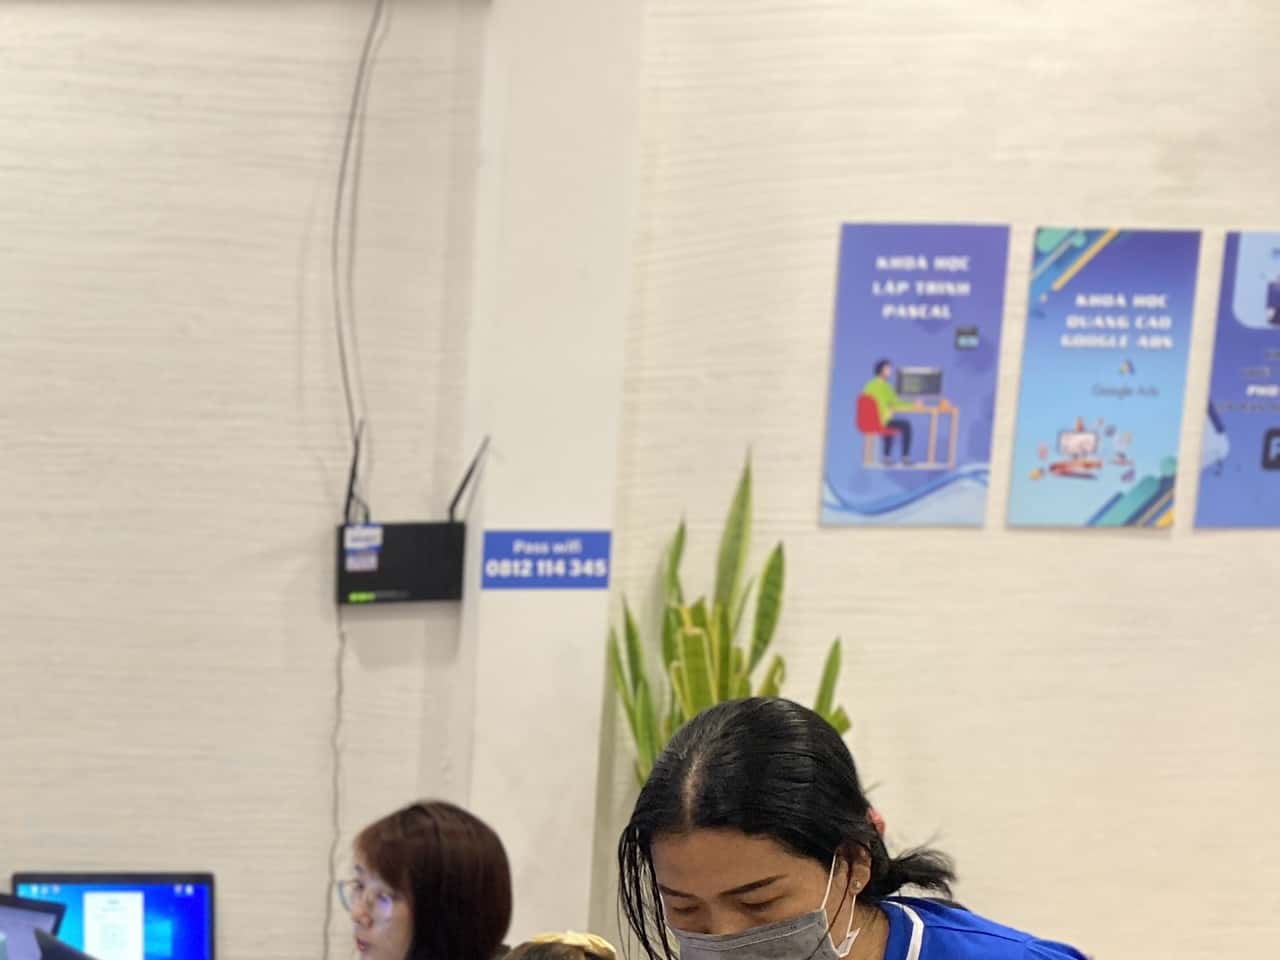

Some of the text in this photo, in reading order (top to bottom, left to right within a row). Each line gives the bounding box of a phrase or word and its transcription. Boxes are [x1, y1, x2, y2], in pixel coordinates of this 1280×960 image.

[881, 303, 952, 320] PASCAL
[1060, 333, 1128, 348] GOOGLE
[512, 539, 549, 555] Pass
[485, 558, 607, 578] 0812 114 345
